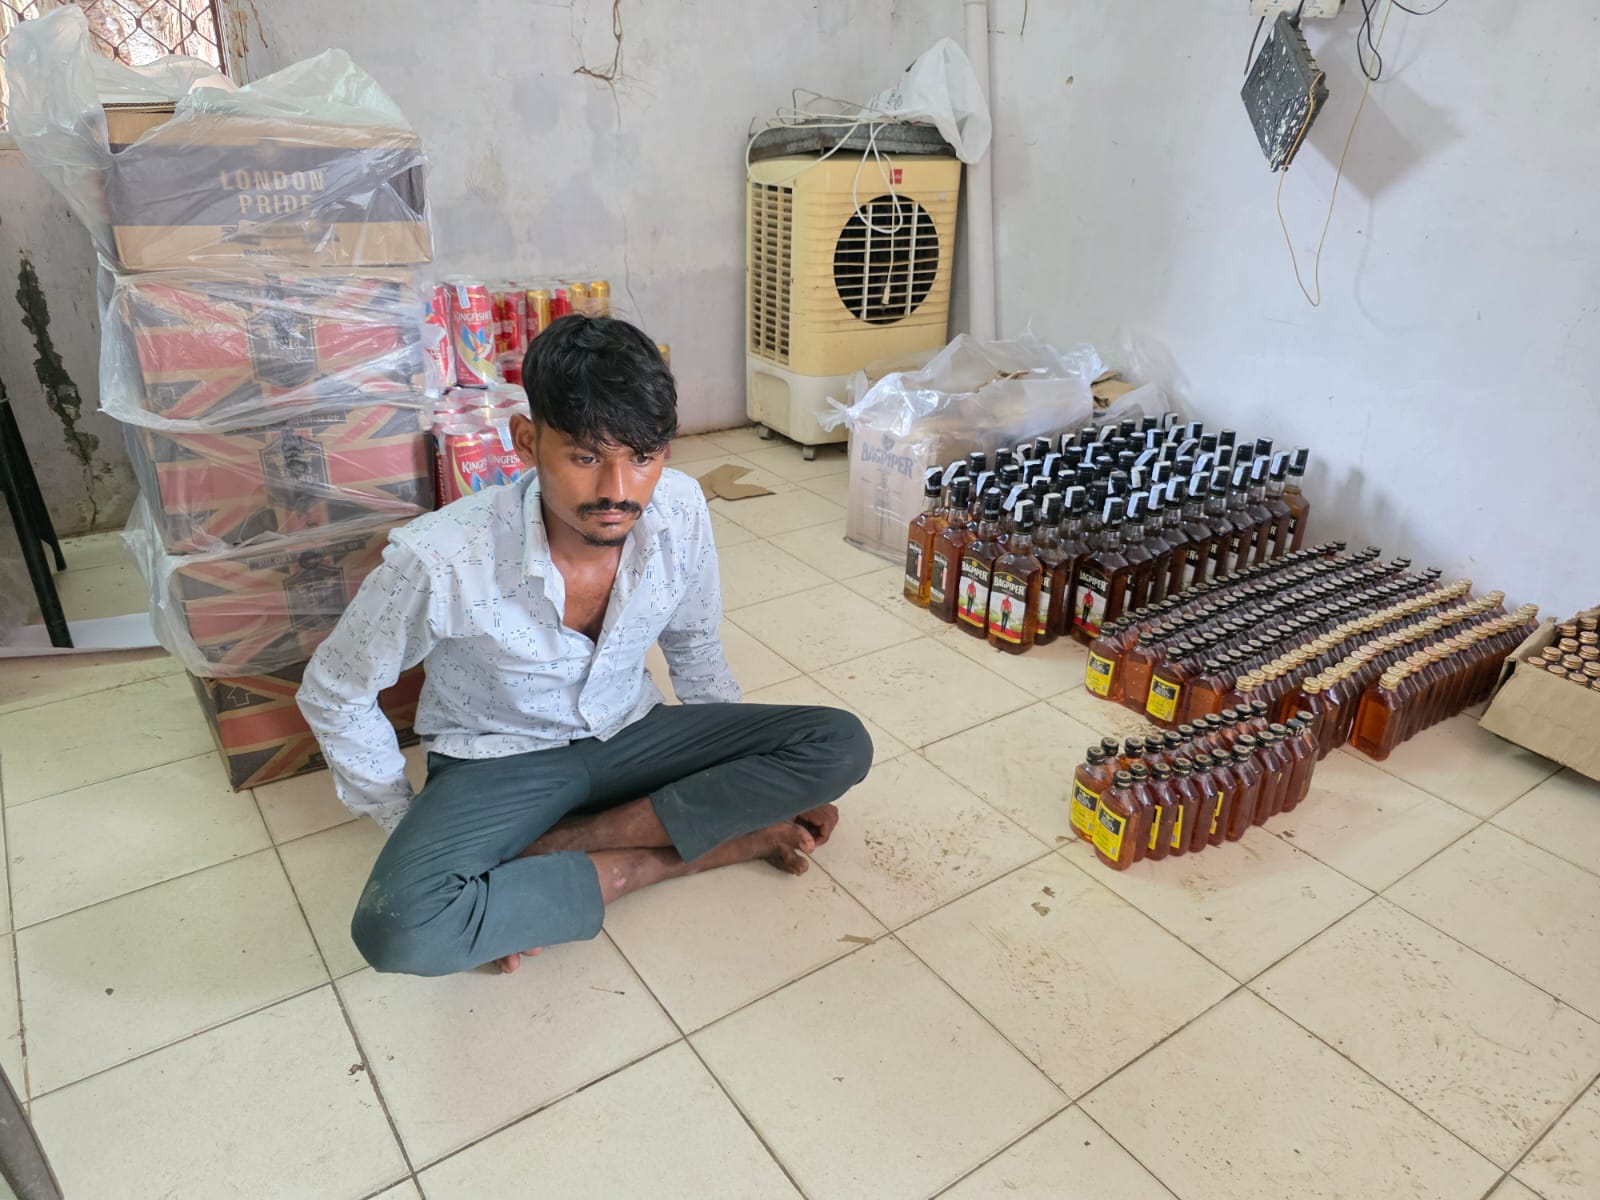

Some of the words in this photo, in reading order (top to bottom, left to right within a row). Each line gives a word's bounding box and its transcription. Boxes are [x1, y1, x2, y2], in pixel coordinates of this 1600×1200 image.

[221, 169, 325, 191] LONDON
[239, 194, 312, 214] PRIDE
[454, 310, 492, 321] KINGFISHE
[861, 441, 913, 479] BAGPIPER
[961, 560, 989, 582] BAGPIPER
[993, 575, 1027, 596] BAGPIPER
